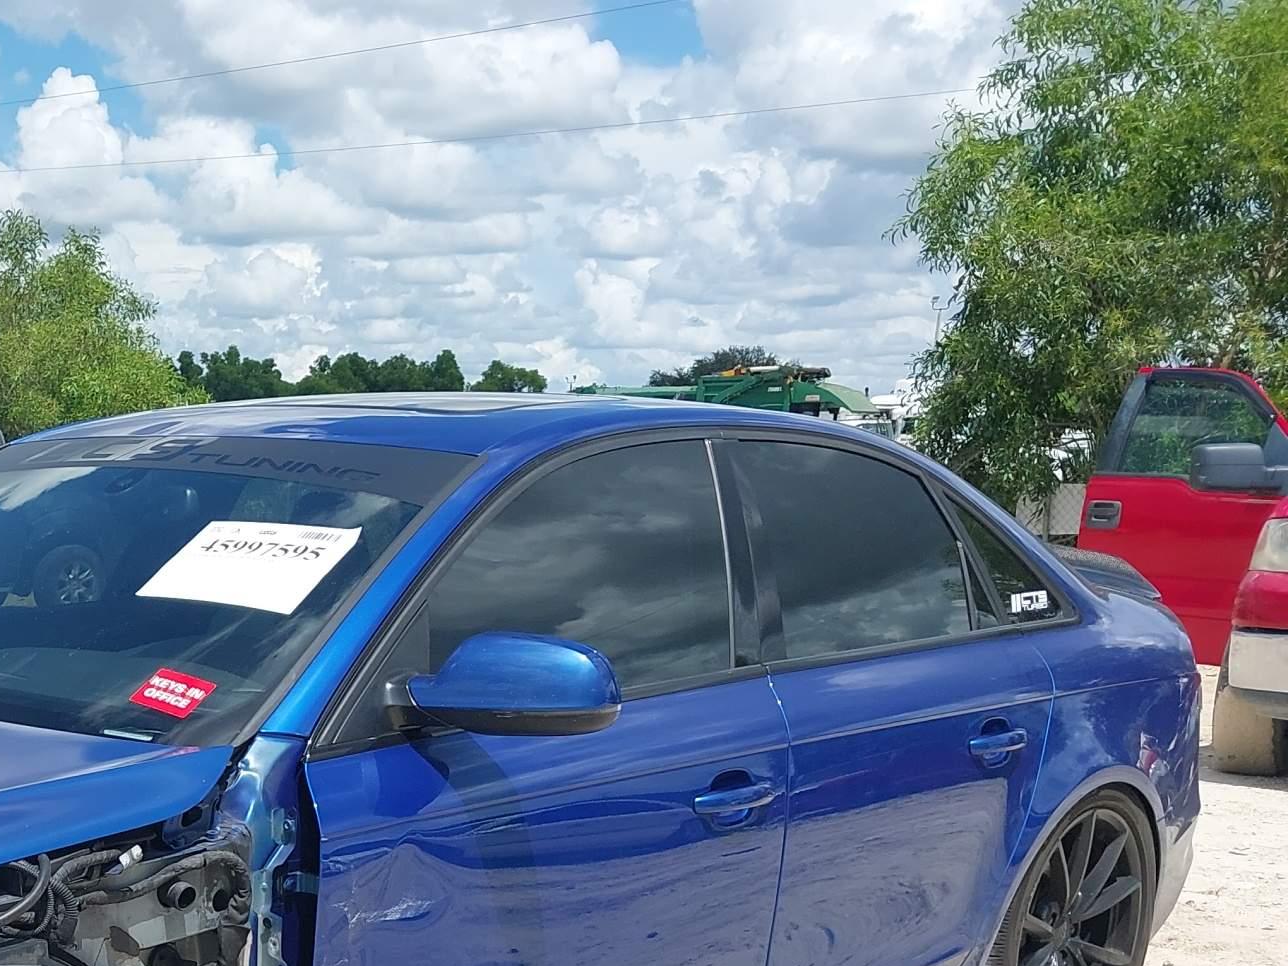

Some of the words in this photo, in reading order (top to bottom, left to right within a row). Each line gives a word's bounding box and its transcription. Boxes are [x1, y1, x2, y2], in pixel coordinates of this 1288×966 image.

[189, 451, 383, 482] TUNING
[200, 538, 327, 561] 45997595
[143, 687, 192, 709] OFFICE
[149, 675, 188, 694] KEYS
[185, 686, 207, 700] IN
